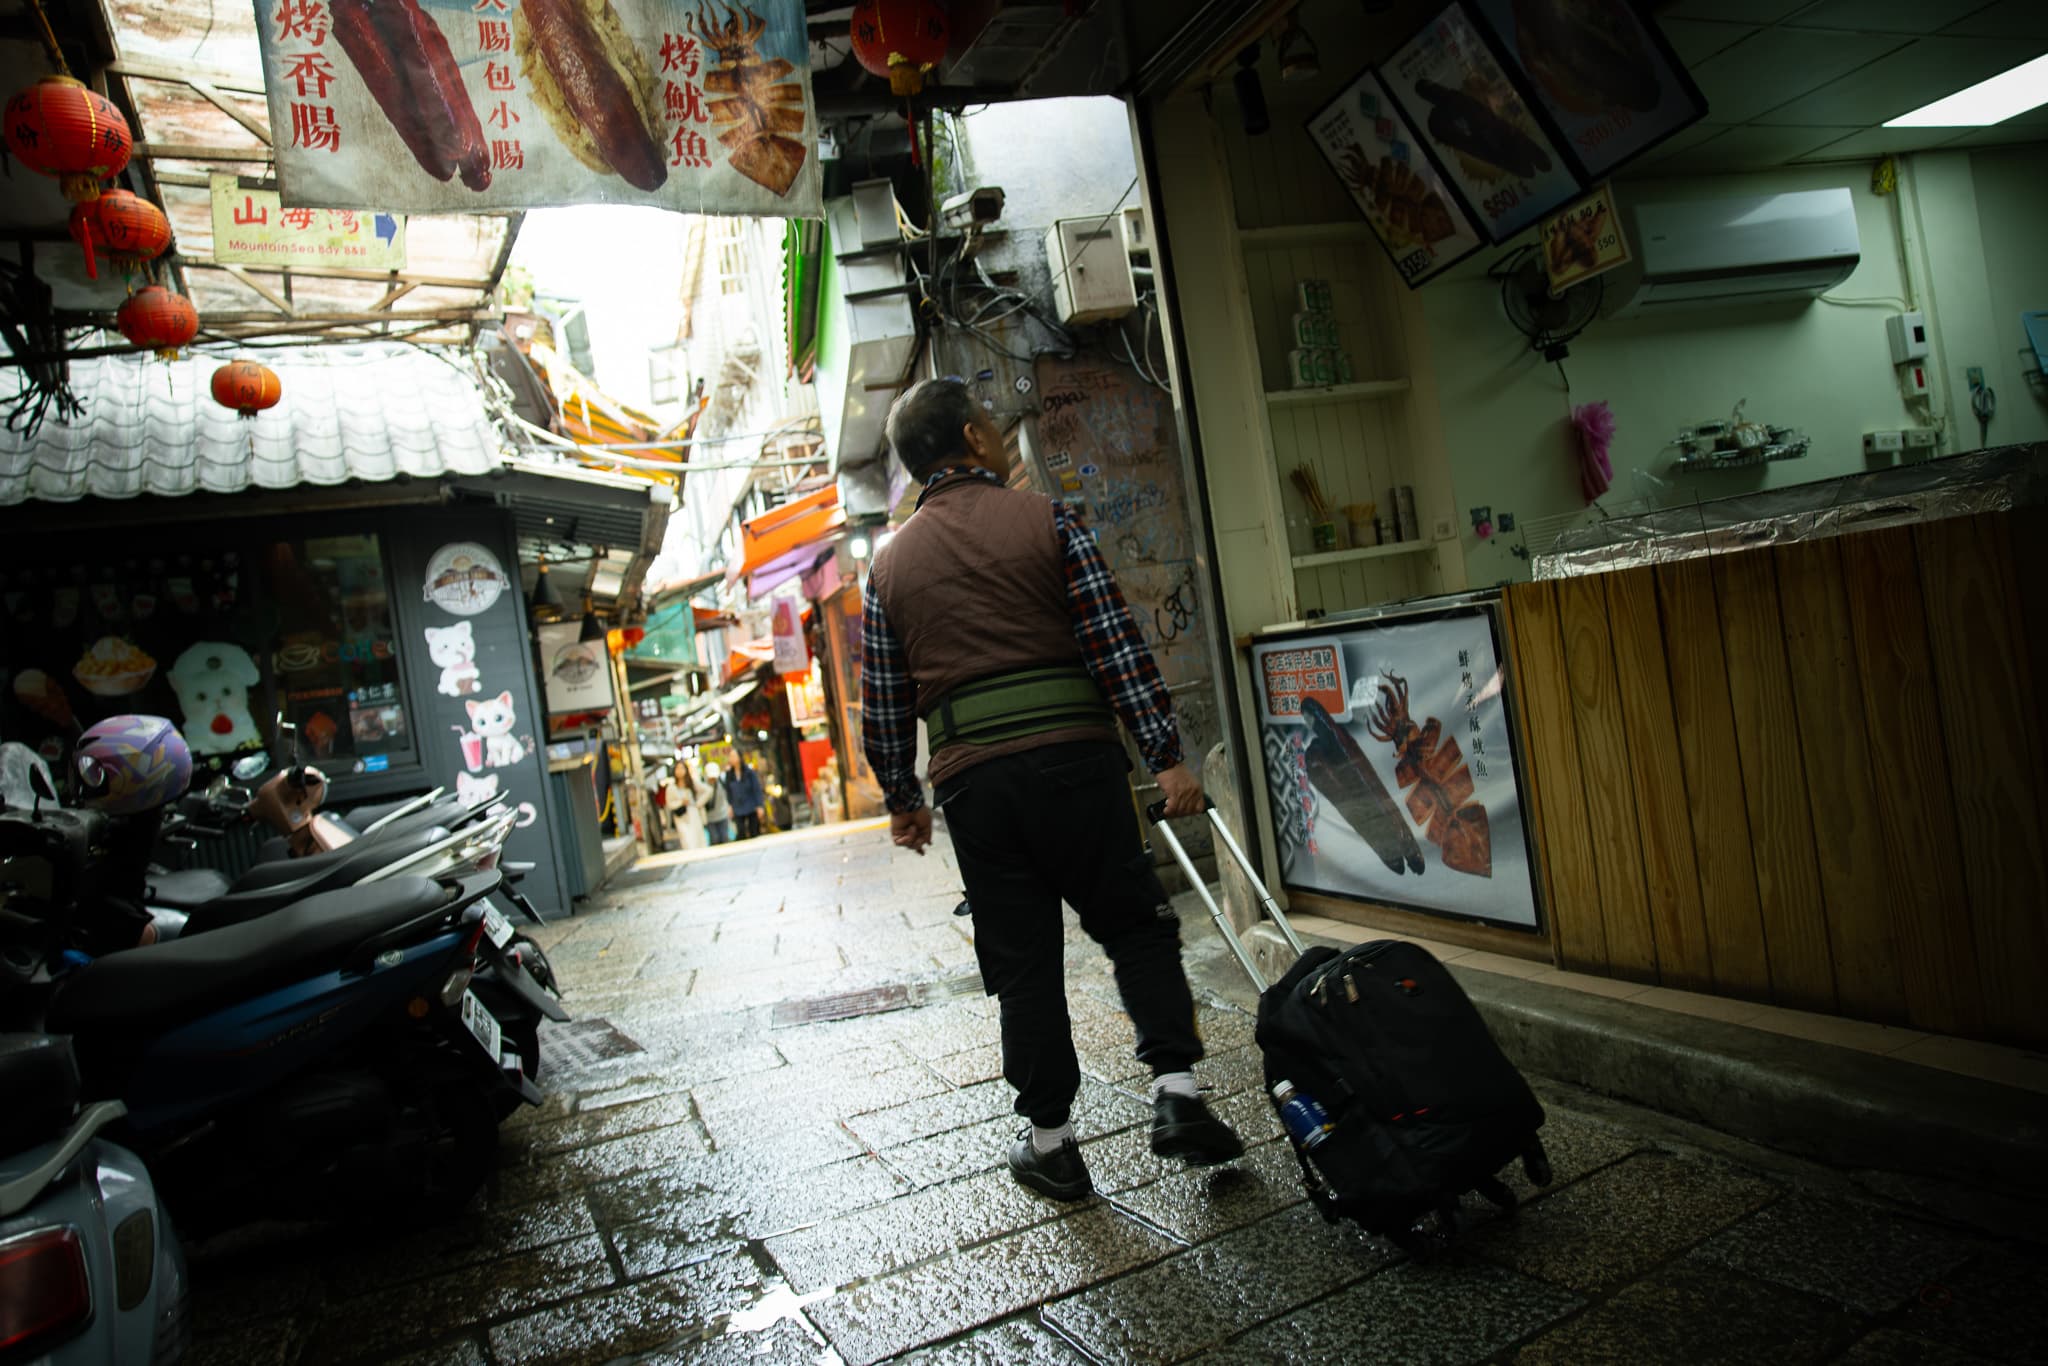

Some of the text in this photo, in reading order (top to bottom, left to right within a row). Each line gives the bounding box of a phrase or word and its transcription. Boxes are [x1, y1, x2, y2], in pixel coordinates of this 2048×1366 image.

[275, 0, 342, 152] 烤香腸
[659, 32, 712, 168] 烤魷魚
[229, 239, 366, 256] Mountain Sea Bay B&B
